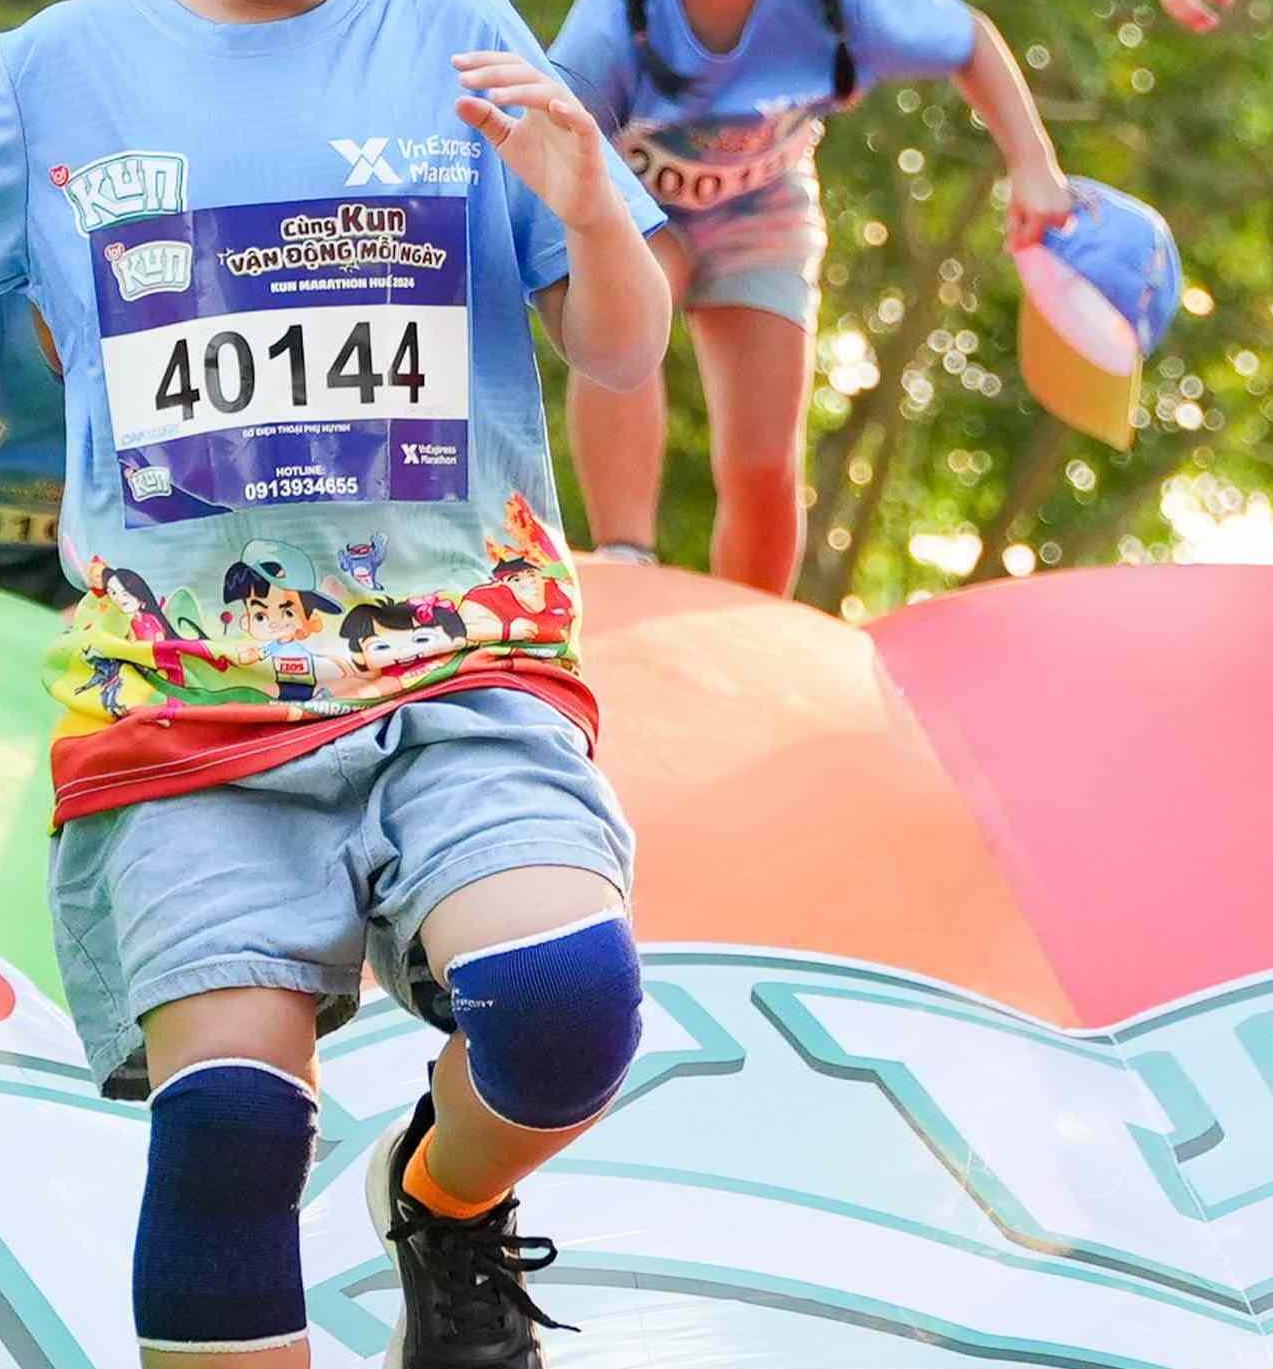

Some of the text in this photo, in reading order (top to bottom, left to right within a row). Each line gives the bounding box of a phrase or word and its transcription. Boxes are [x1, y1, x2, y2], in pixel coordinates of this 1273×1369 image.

[283, 206, 404, 237] Cùng Kun
[230, 248, 278, 275] VẬN
[285, 241, 353, 270] ĐỘNG
[399, 245, 445, 265] NGÀY
[270, 280, 297, 293] KUN
[299, 277, 367, 291] MARATHON
[154, 320, 425, 421] 40144
[244, 476, 359, 501] 0913934655
